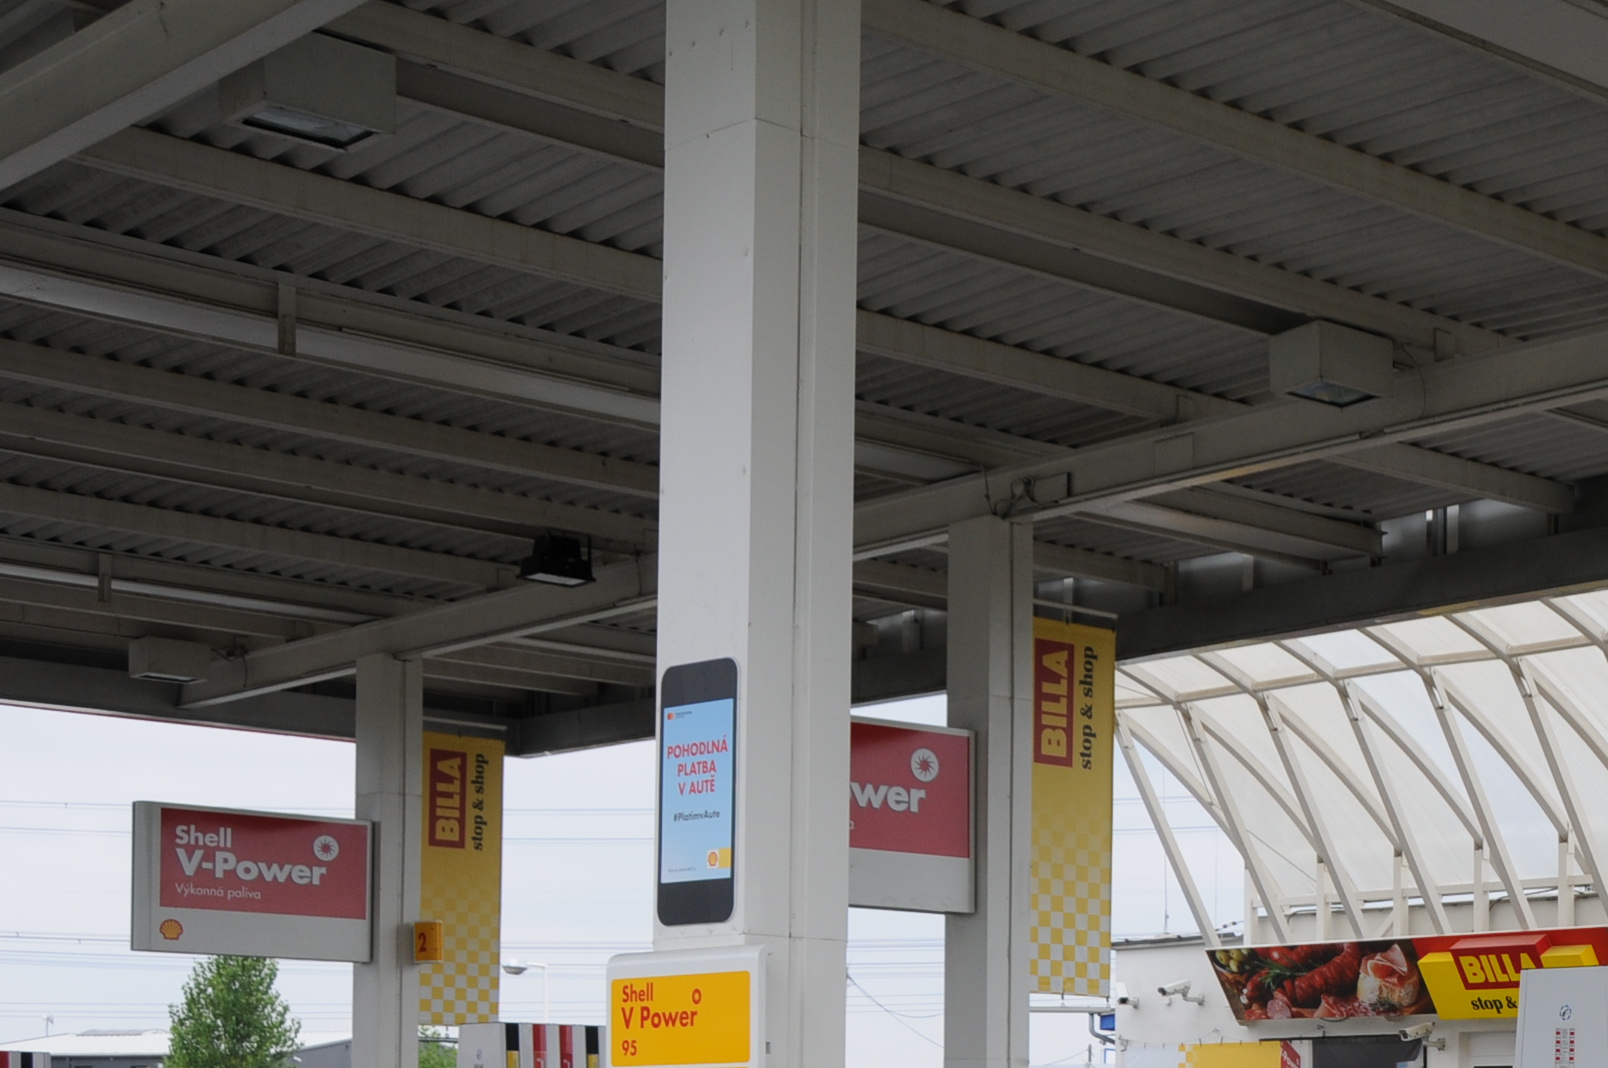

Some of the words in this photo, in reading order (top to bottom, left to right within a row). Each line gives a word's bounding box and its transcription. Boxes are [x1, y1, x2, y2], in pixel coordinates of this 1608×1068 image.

[1080, 645, 1098, 698] shop
[1041, 649, 1069, 758] BILLA
[1081, 703, 1093, 719] &
[667, 734, 729, 760] POHODLNÁ
[1081, 724, 1097, 770] stop
[474, 753, 489, 793] shop
[677, 760, 717, 777] PLATBA
[678, 782, 686, 795] V
[689, 774, 715, 795] AUTĚ
[436, 756, 462, 842] BILLA
[850, 781, 926, 814] wer
[175, 825, 232, 848] Shell
[474, 816, 486, 850] stop
[175, 848, 327, 886] V-Power
[175, 882, 224, 898] Výkonná
[227, 886, 261, 900] paliva
[417, 932, 427, 953] 2
[622, 982, 654, 1003] Shell
[1471, 997, 1503, 1014] stop
[1506, 996, 1518, 1009] &
[622, 1040, 637, 1056] 95
